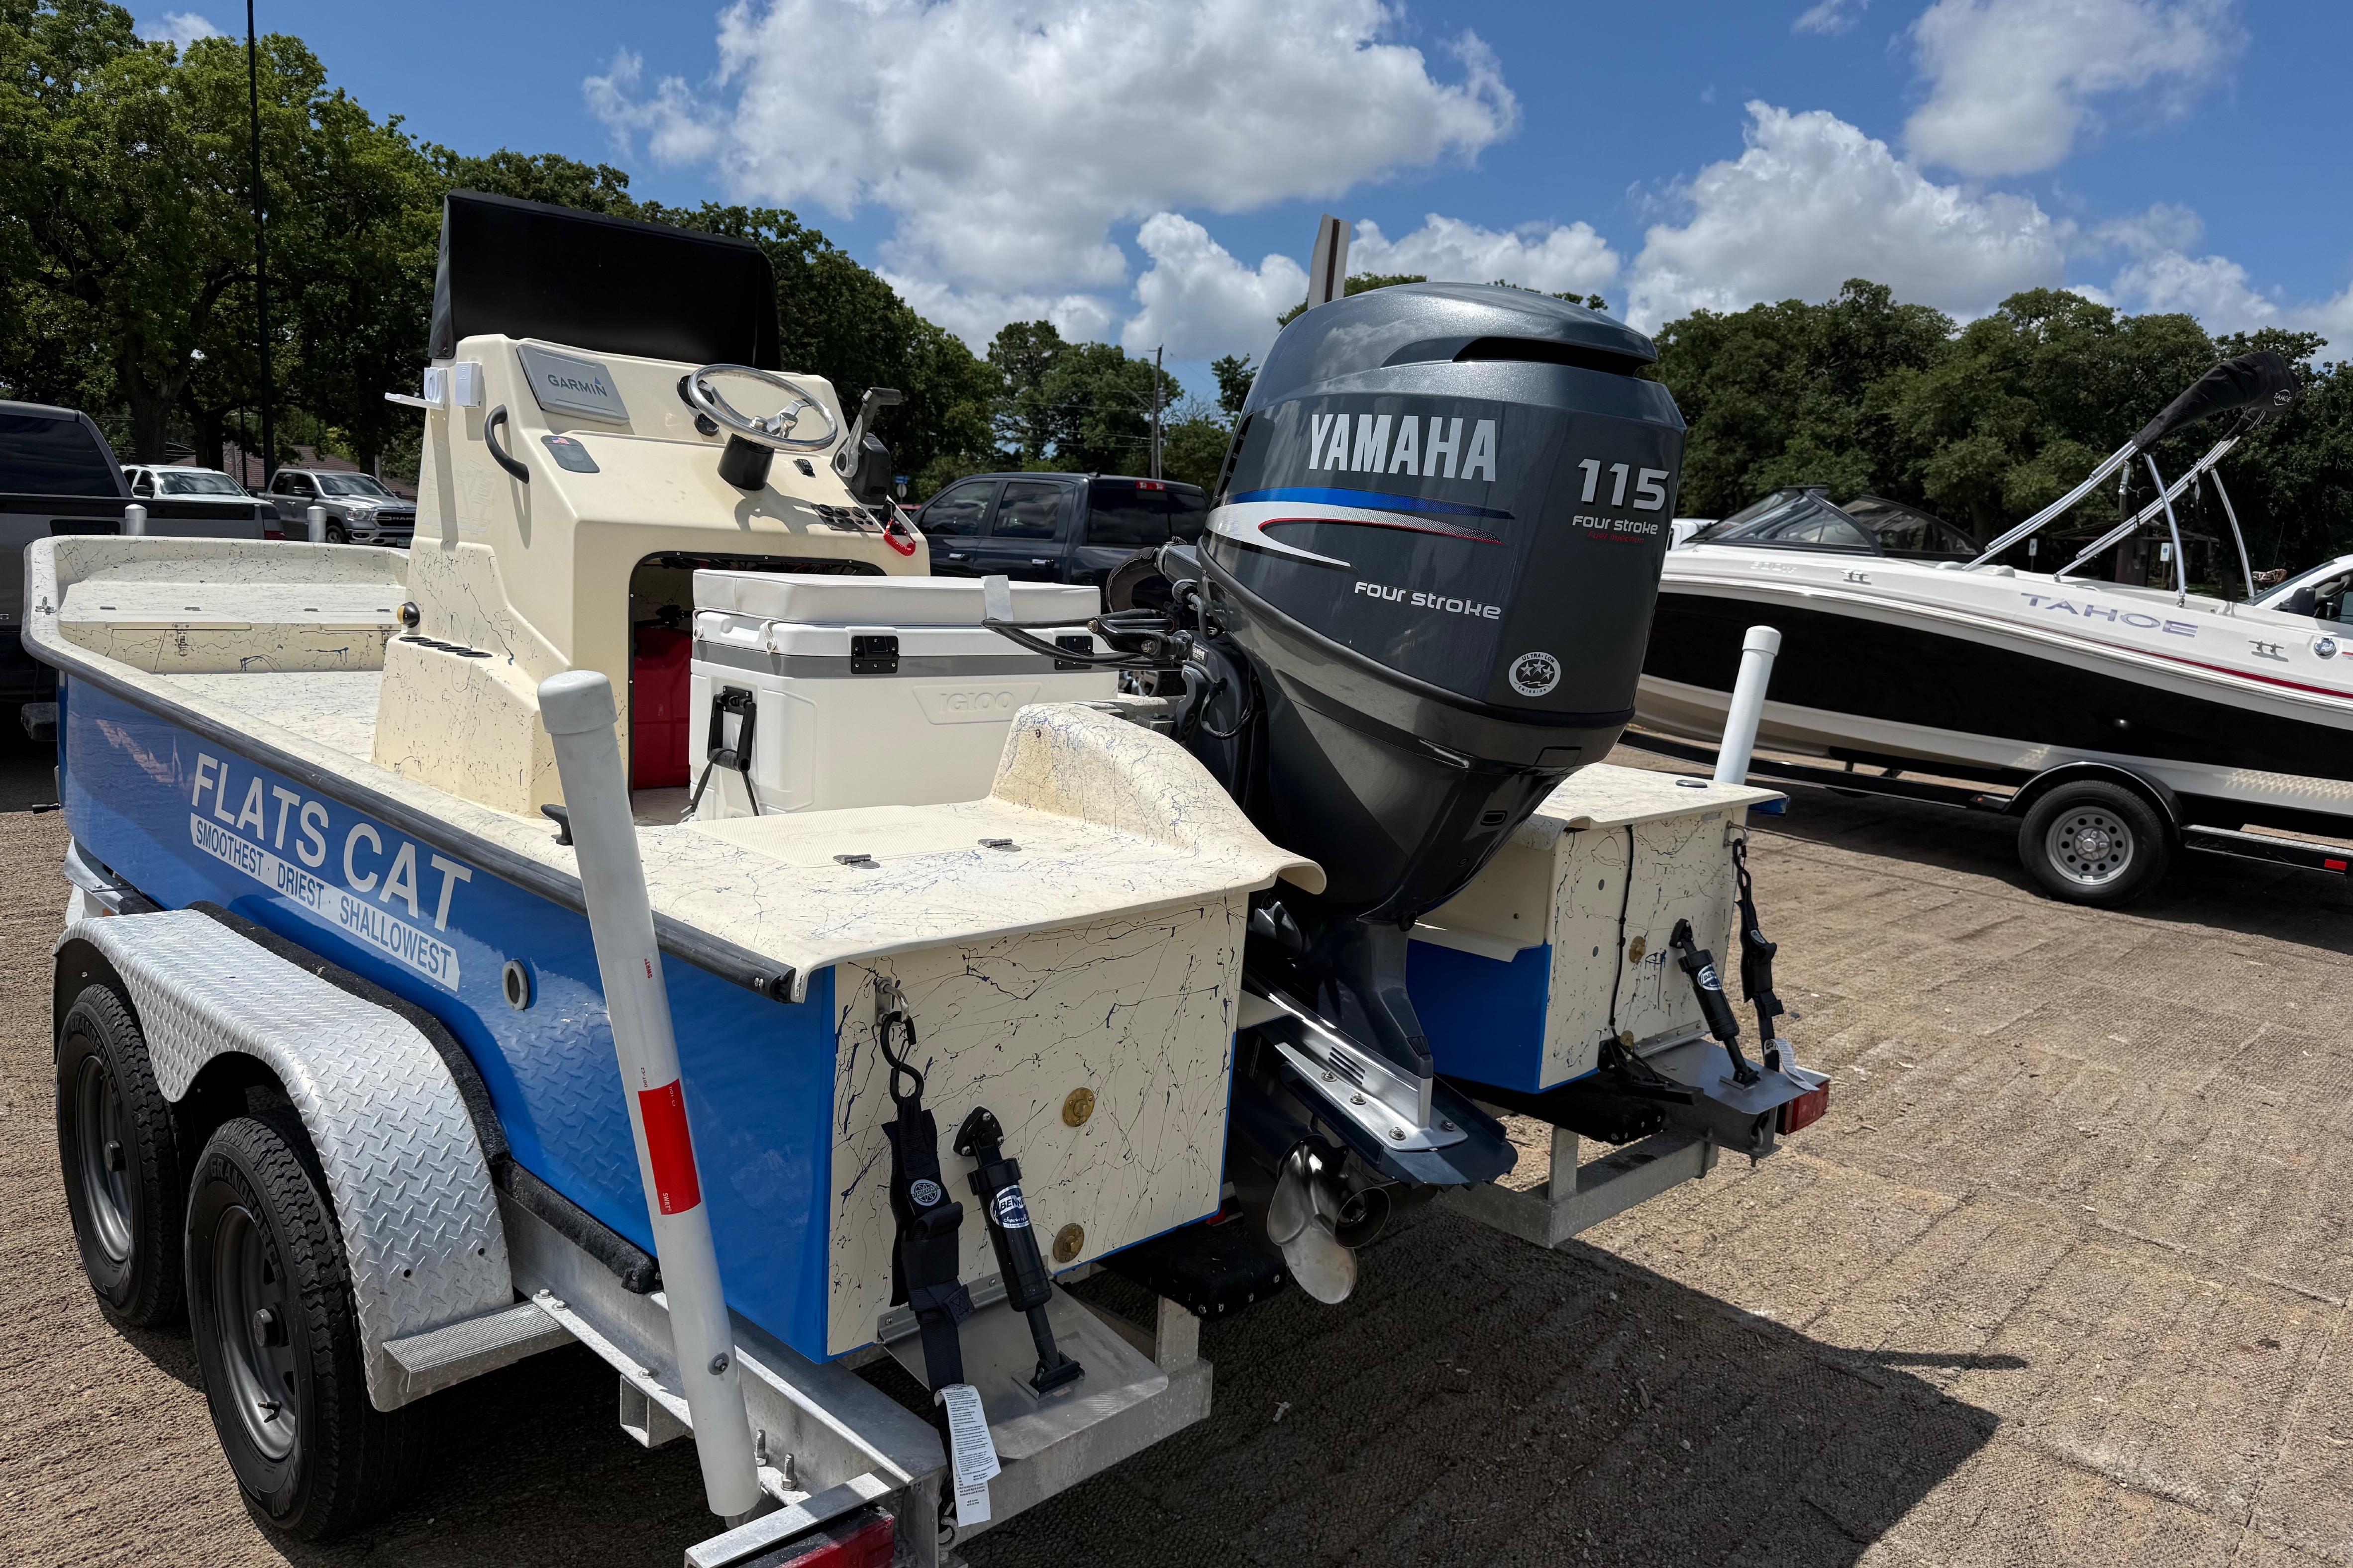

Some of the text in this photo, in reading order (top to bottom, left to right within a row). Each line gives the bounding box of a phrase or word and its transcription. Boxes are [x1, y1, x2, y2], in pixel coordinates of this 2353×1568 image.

[547, 374, 608, 397] GARMIN
[2274, 393, 2292, 402] TAHOE
[1309, 414, 1496, 482] YAMAHA
[1578, 459, 1670, 512] 115
[2021, 592, 2198, 638] TAHOE
[939, 692, 1015, 713] IGLOO
[192, 752, 472, 932] FLATS CAT
[197, 819, 451, 979] SMOOTHEST DRIEST SHALLOWEST
[70, 1015, 120, 1106] GRANDFORCE
[210, 1158, 285, 1281] GRANDFORCE
